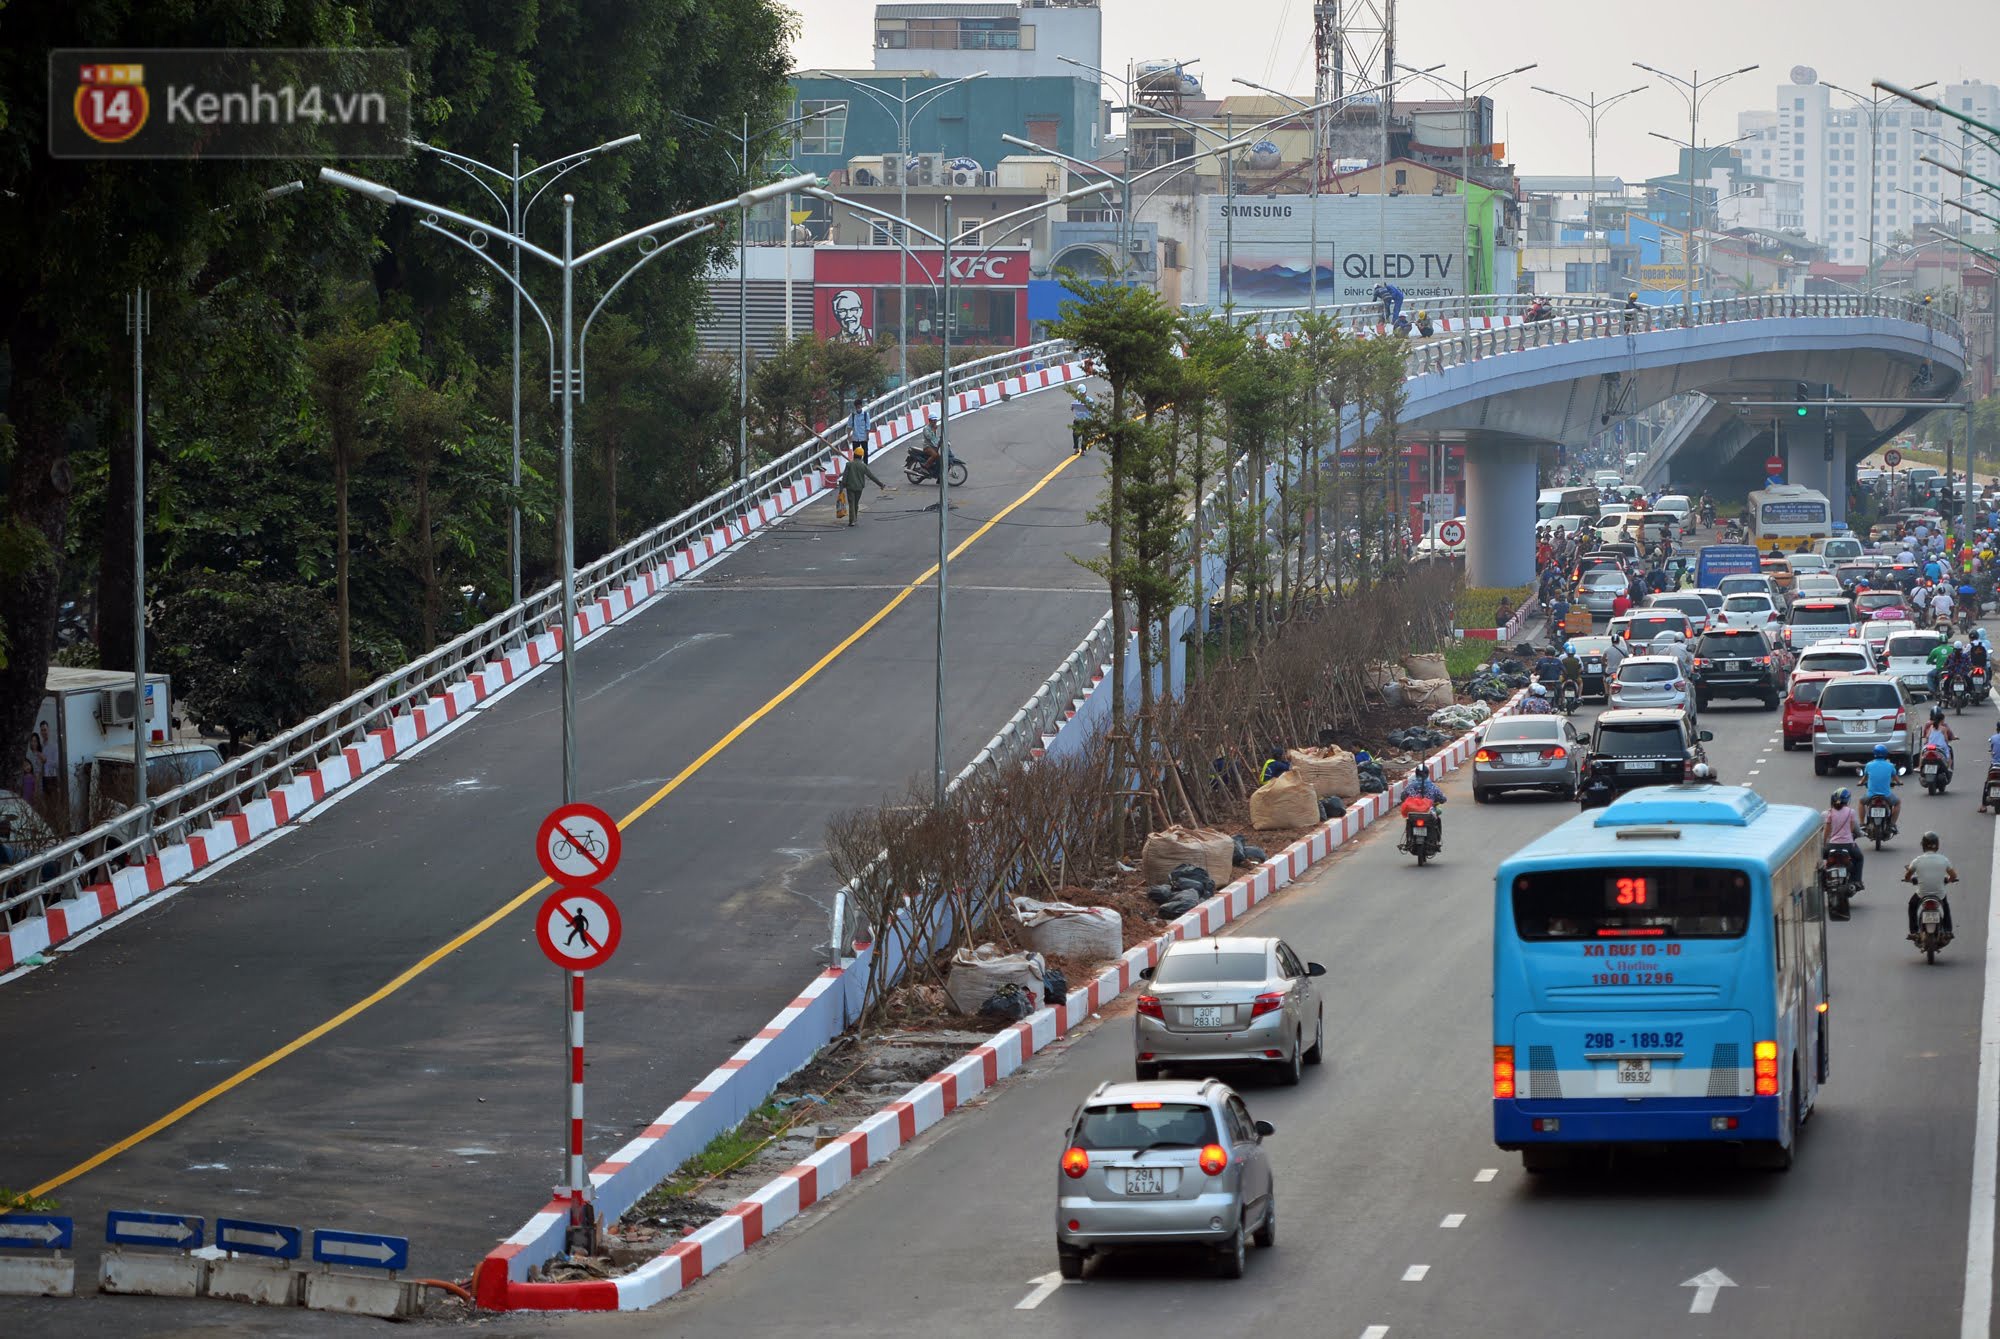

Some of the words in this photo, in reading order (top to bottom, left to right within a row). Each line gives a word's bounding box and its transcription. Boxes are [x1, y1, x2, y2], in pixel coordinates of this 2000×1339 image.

[1220, 205, 1292, 217] SAMSUNG
[936, 256, 1009, 279] KFC
[1342, 253, 1415, 279] QLED
[1419, 253, 1453, 279] TV
[1416, 286, 1441, 297] NGHỆ
[1443, 288, 1454, 296] TV
[1445, 527, 1451, 536] 4
[1615, 877, 1647, 905] 31
[1609, 944, 1637, 956] BUS
[1617, 960, 1659, 971] Hotline
[1592, 973, 1630, 985] 1900
[1635, 972, 1674, 985] 1296
[1199, 1007, 1215, 1017] 30F
[1584, 1032, 1615, 1049] 29B
[1631, 1031, 1684, 1048] 189.92
[1620, 1071, 1650, 1082] 189.92
[1135, 1168, 1154, 1181] 29A
